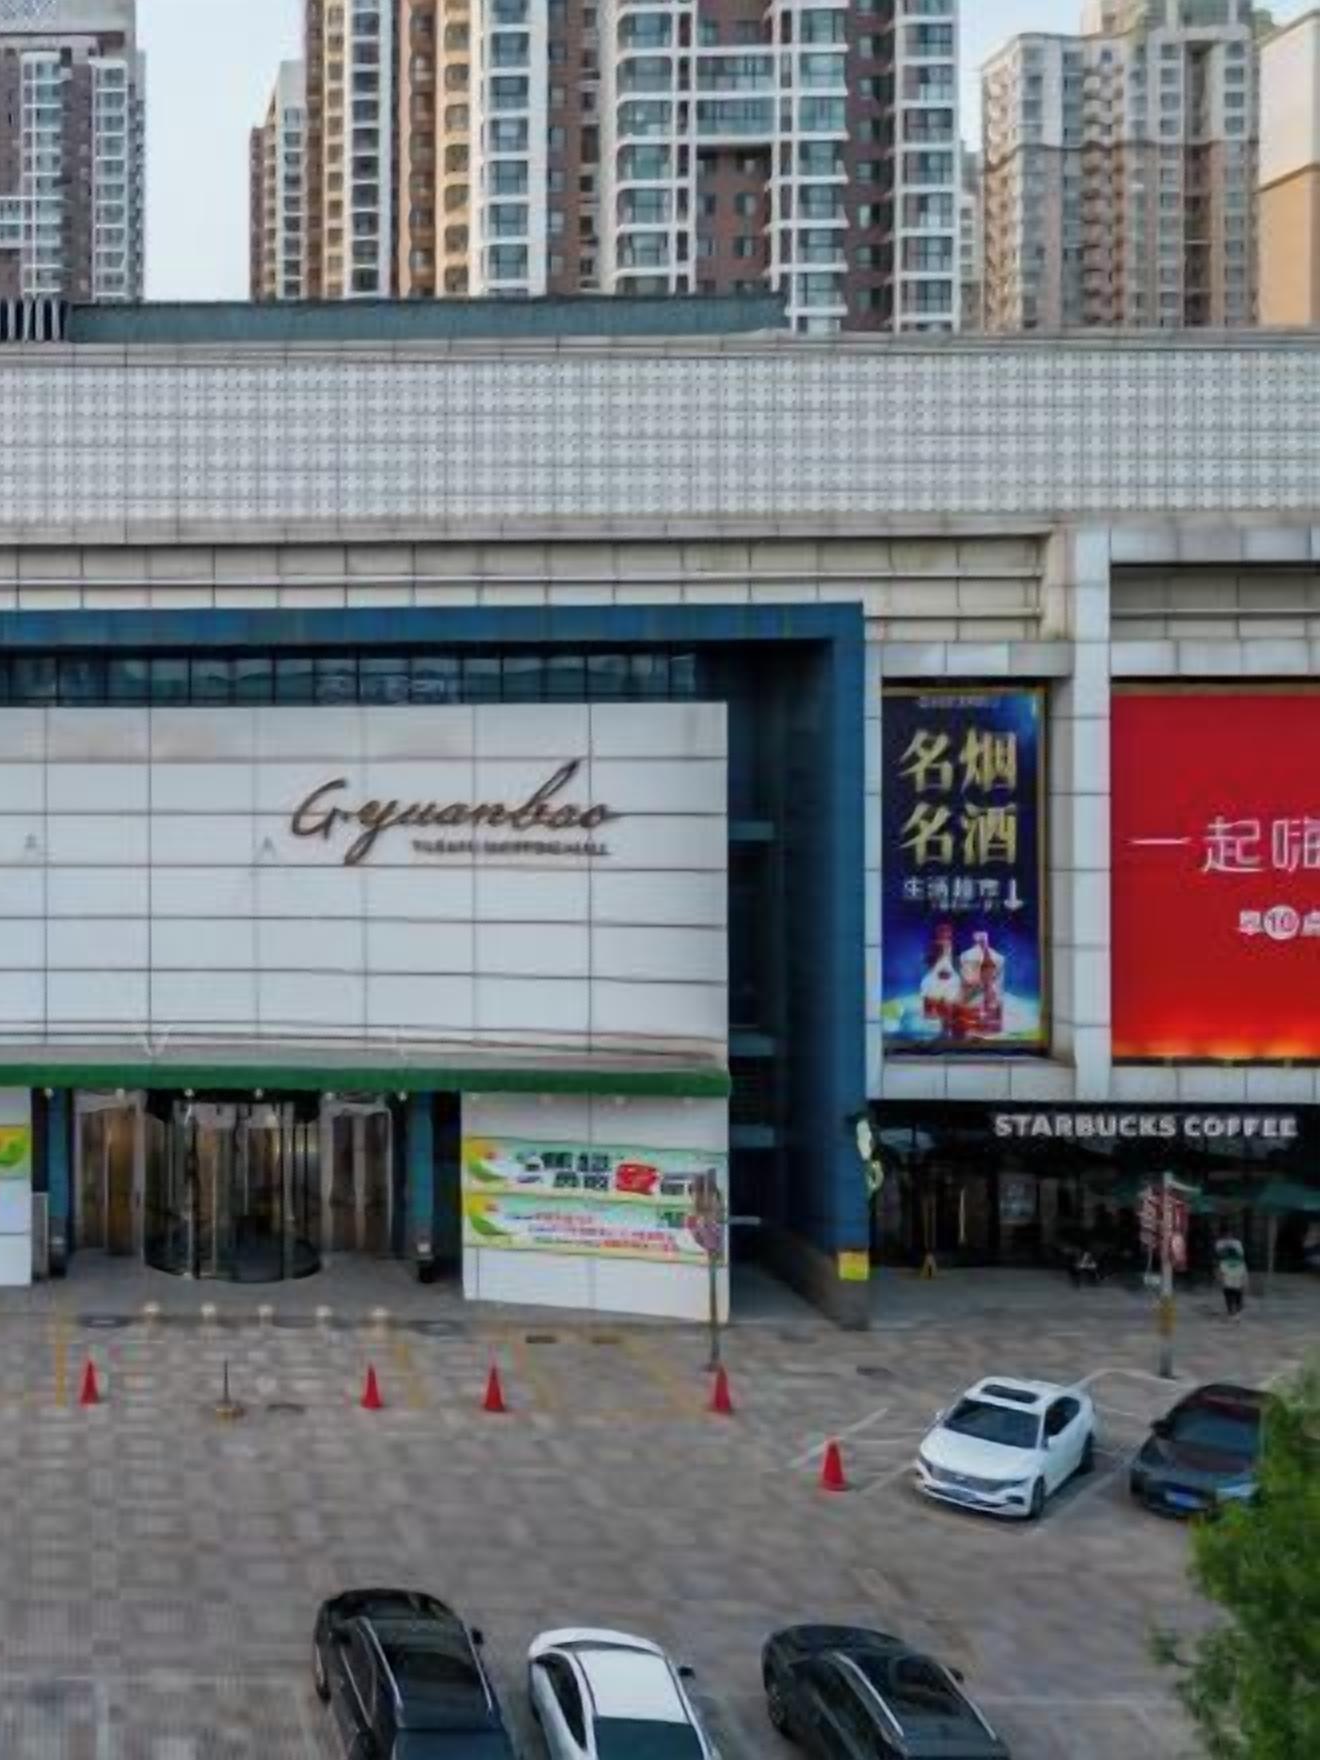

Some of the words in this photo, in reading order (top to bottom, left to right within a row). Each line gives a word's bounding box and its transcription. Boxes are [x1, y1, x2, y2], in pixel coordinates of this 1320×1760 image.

[899, 726, 1018, 793] 名烟
[899, 801, 1018, 867] 名酒
[995, 1113, 1176, 1138] STARBUCKS
[1183, 1112, 1299, 1138] COFFEE
